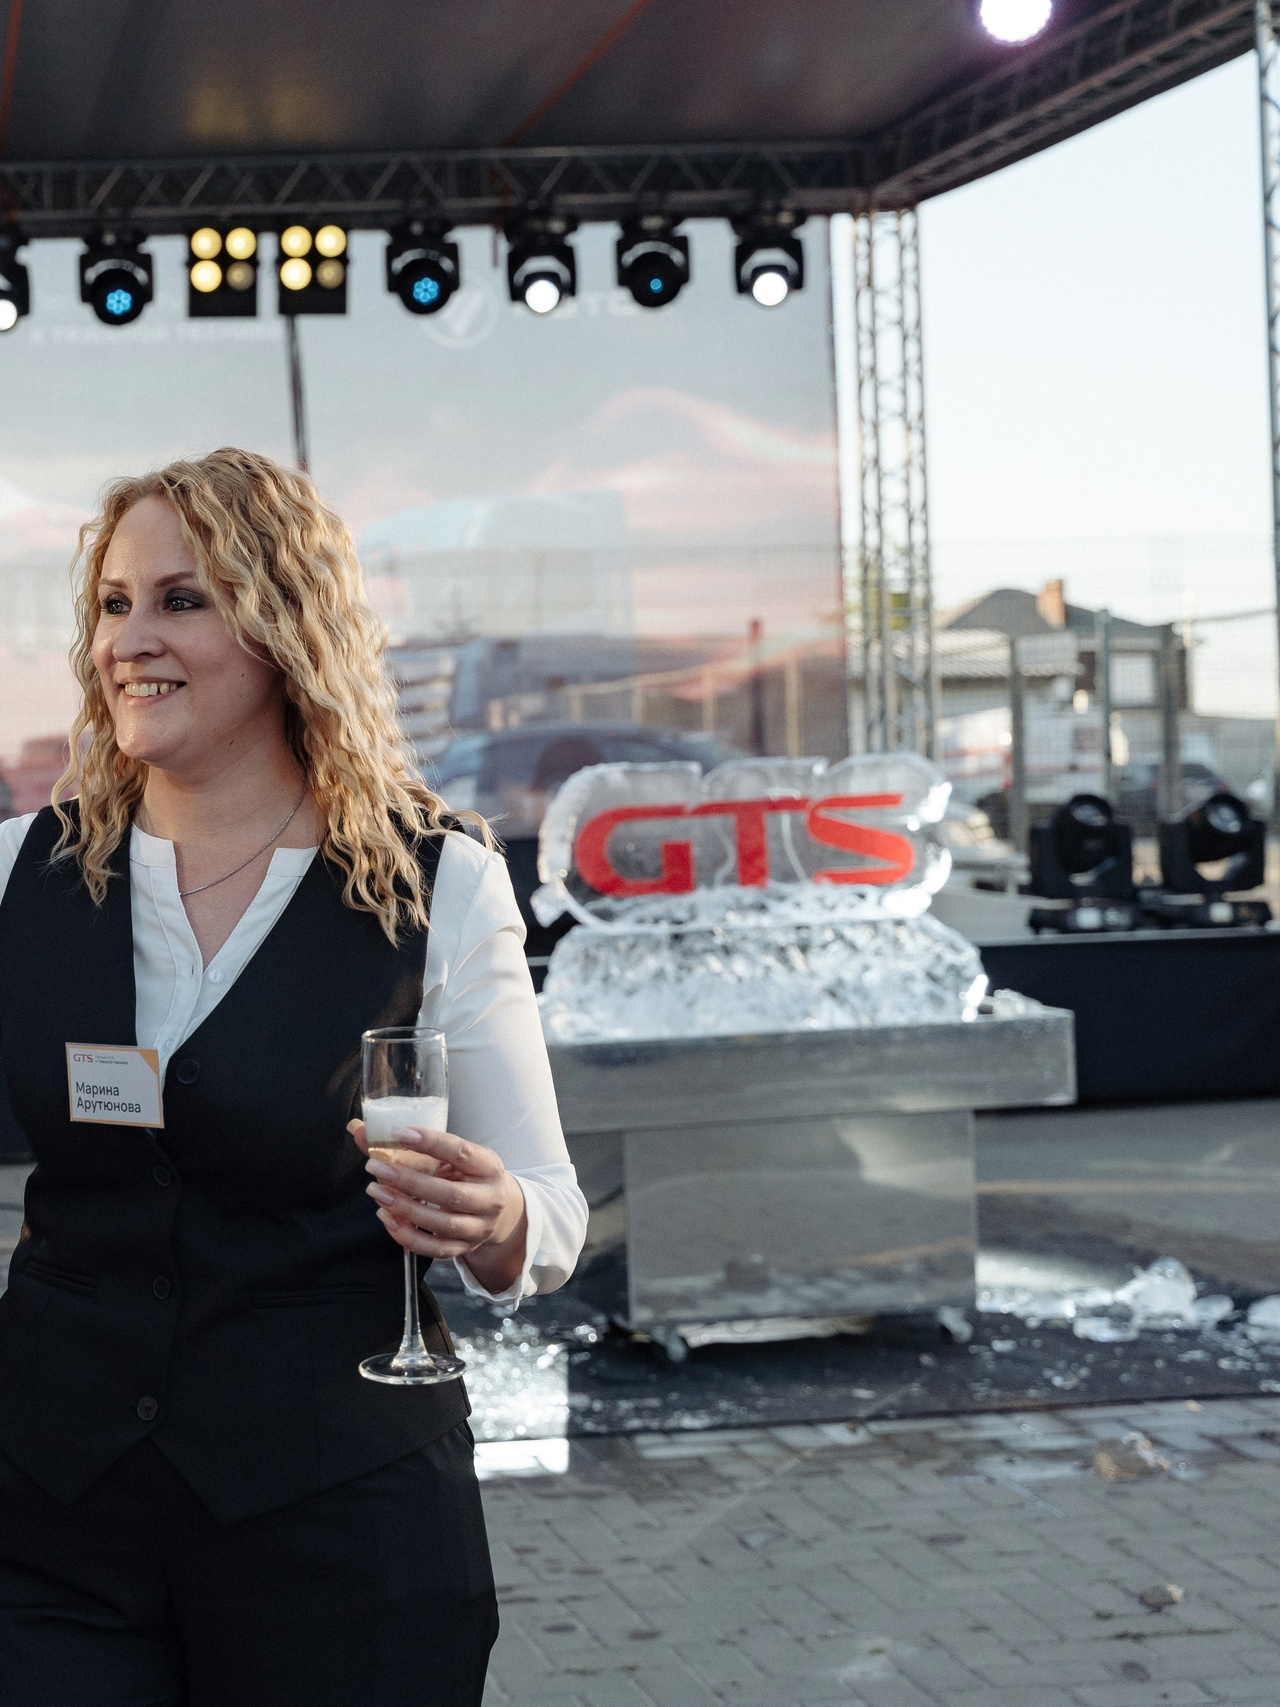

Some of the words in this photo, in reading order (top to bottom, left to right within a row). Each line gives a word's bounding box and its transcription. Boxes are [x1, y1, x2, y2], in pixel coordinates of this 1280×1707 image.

[575, 793, 915, 897] GTS
[73, 1053, 93, 1062] GTS
[75, 1081, 120, 1098] Марина
[76, 1096, 141, 1114] Арутюнова
